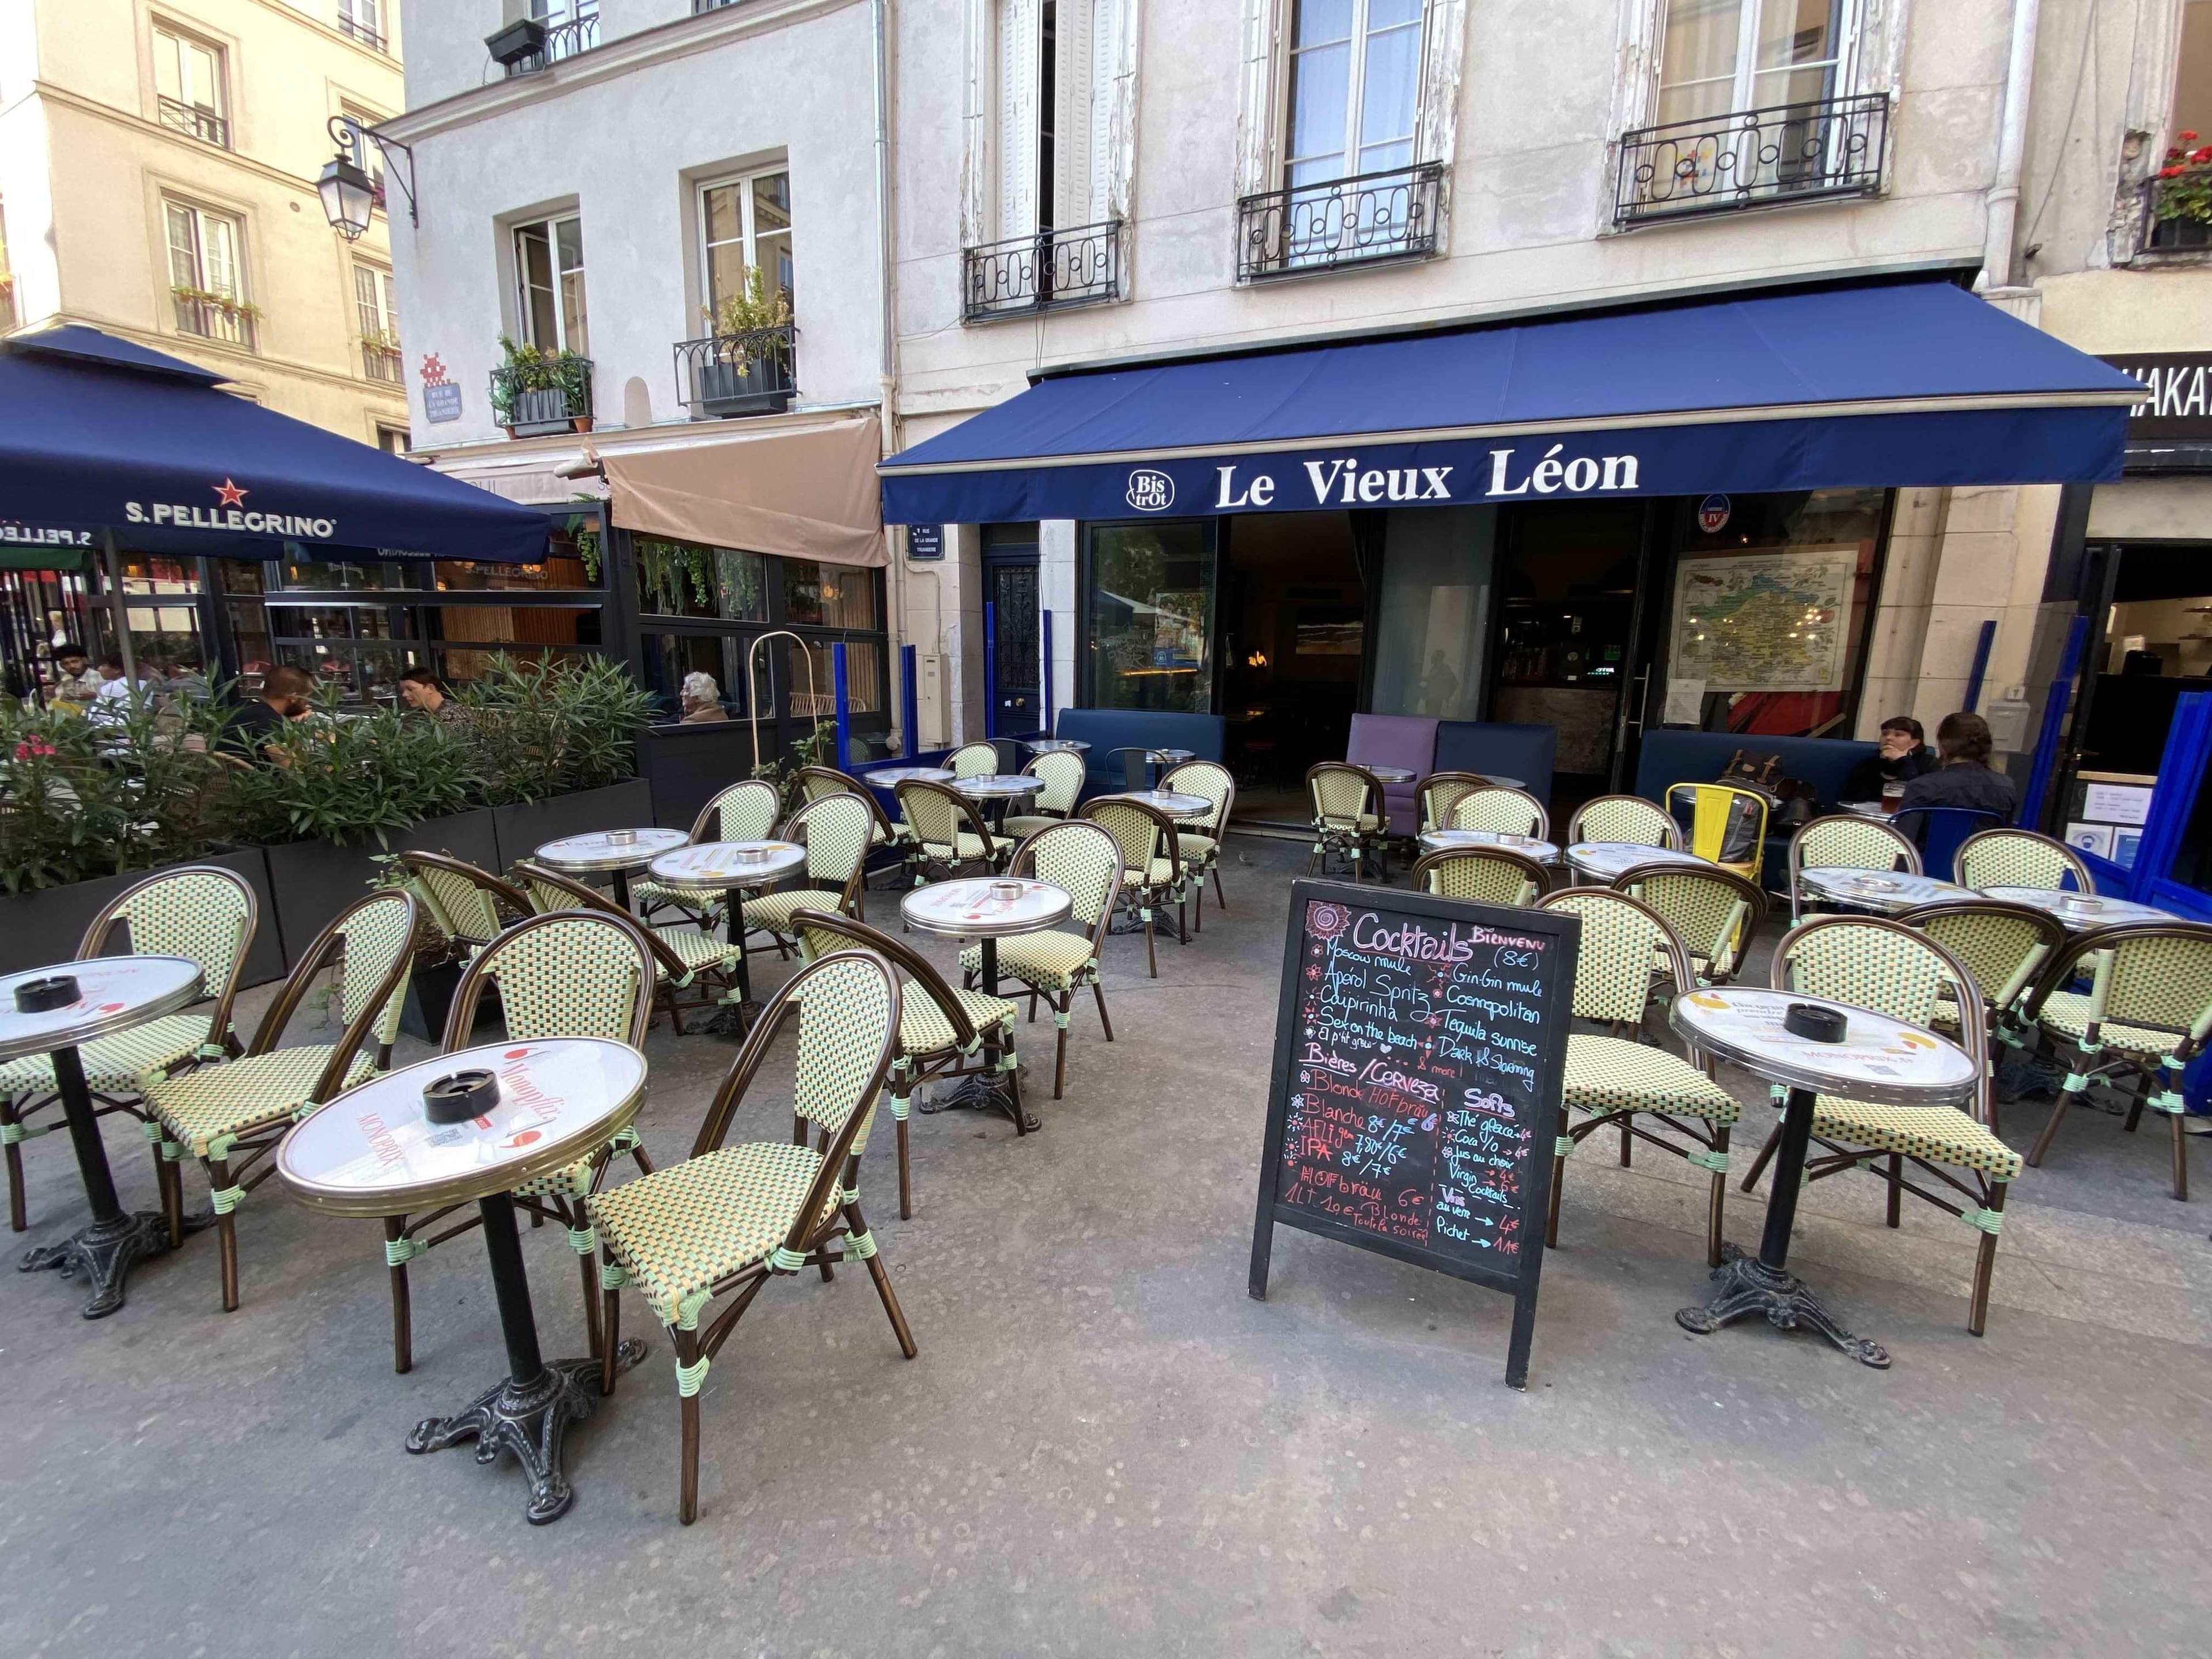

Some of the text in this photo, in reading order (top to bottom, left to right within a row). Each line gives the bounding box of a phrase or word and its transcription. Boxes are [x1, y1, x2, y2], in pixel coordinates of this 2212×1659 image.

[2122, 366, 2212, 416] AKA
[1137, 476, 1165, 493] Bis
[1215, 444, 1640, 509] Le Vieux Léon
[126, 501, 336, 538] S.PELLEGRINO
[1353, 912, 1474, 963] Cocktails
[1374, 956, 1411, 976] mule
[1494, 946, 1539, 971] (8€)
[1506, 979, 1542, 998] mule
[1317, 1006, 1418, 1050] Sex on the beach
[1434, 1008, 1487, 1043] Tequila
[1298, 1042, 1358, 1073] Bières
[1300, 1093, 1366, 1130] Blanche
[1457, 1110, 1480, 1127] Thé
[1464, 1088, 1516, 1118] Softs
[357, 1113, 406, 1166] MONOPRIX
[1300, 1135, 1334, 1162] IPA
[1450, 1145, 1515, 1169] Jus au choix
[1449, 1162, 1478, 1187] Virgin
[1398, 1188, 1425, 1207] 6€
[1435, 1200, 1450, 1213] au
[1499, 1214, 1520, 1235] 4€
[1436, 1215, 1520, 1256] Pichet 11€
